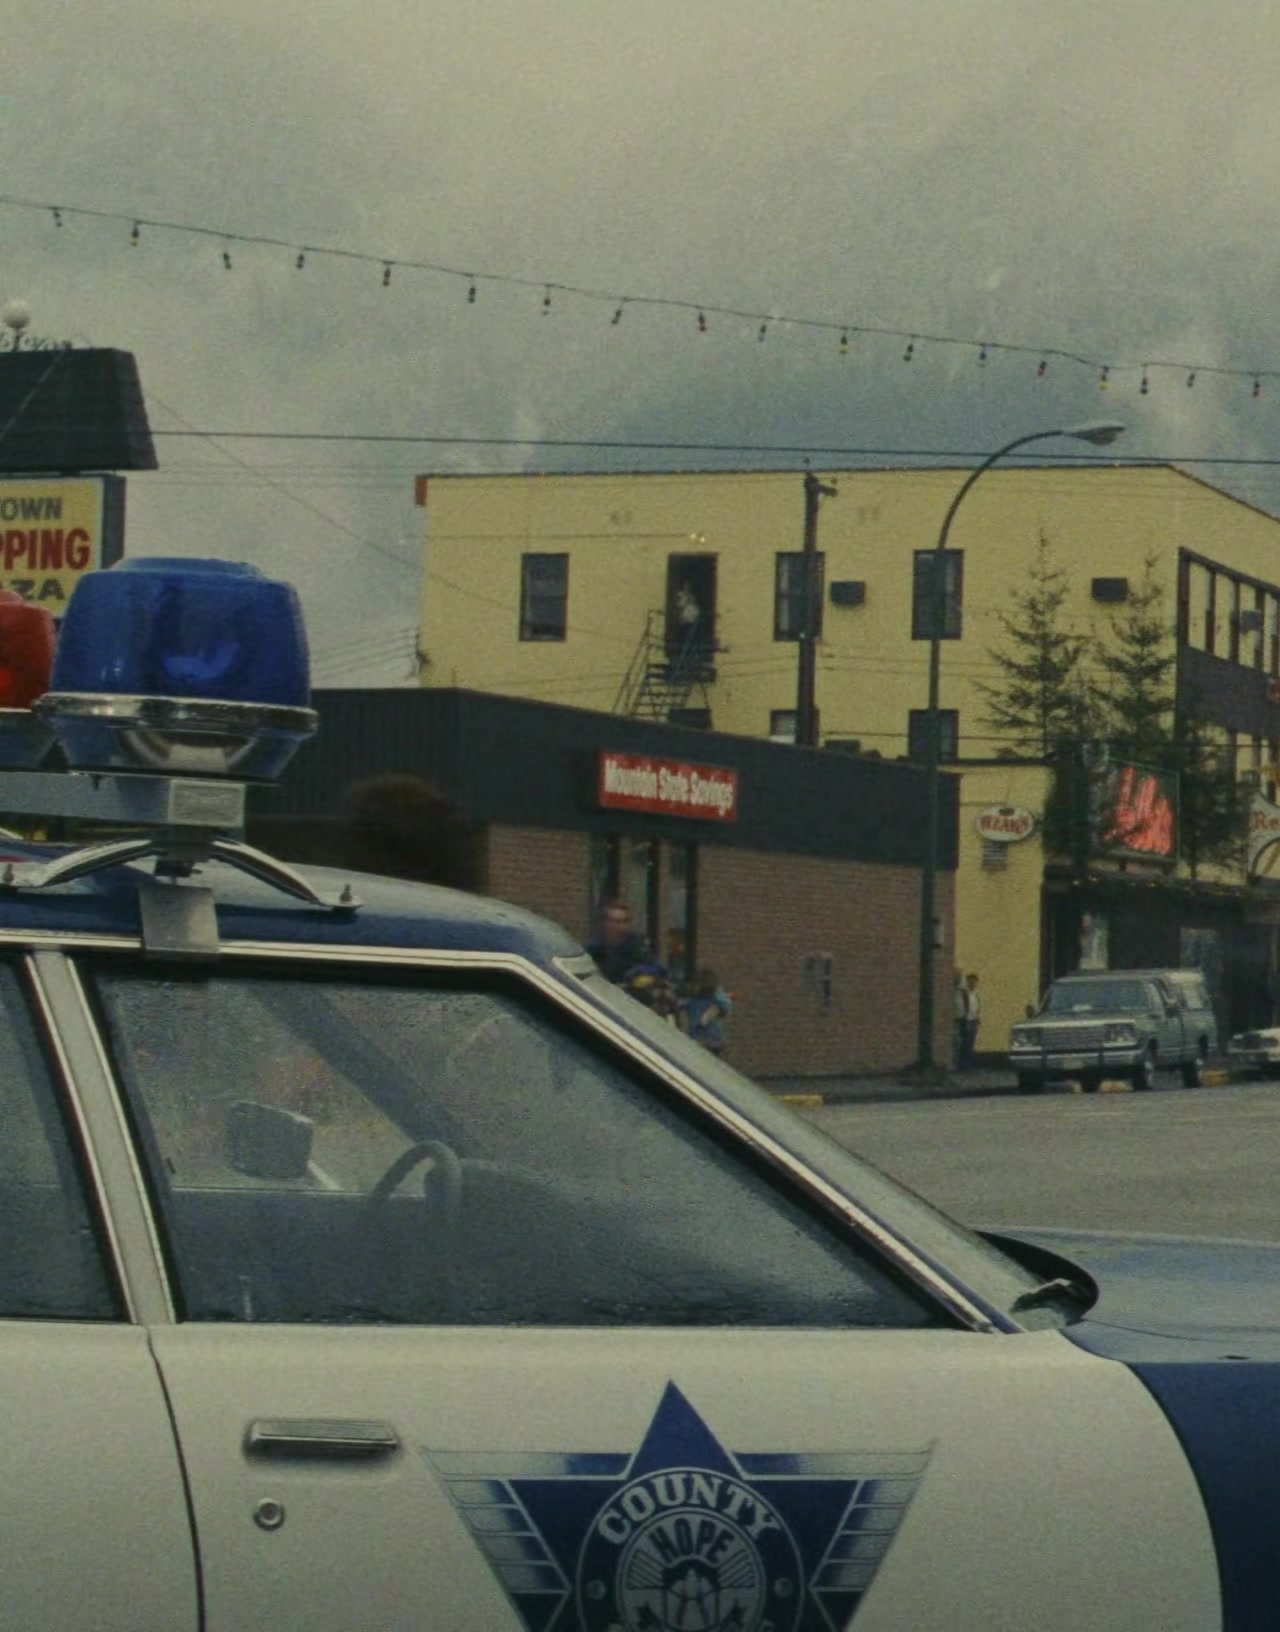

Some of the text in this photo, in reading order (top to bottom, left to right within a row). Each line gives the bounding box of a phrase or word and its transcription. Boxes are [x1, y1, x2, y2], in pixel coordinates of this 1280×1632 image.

[0, 528, 90, 571] PING
[0, 578, 66, 601] ZA
[604, 758, 658, 800] Mountain
[598, 1473, 782, 1545] COUNTY
[648, 1517, 735, 1564] HOPE
